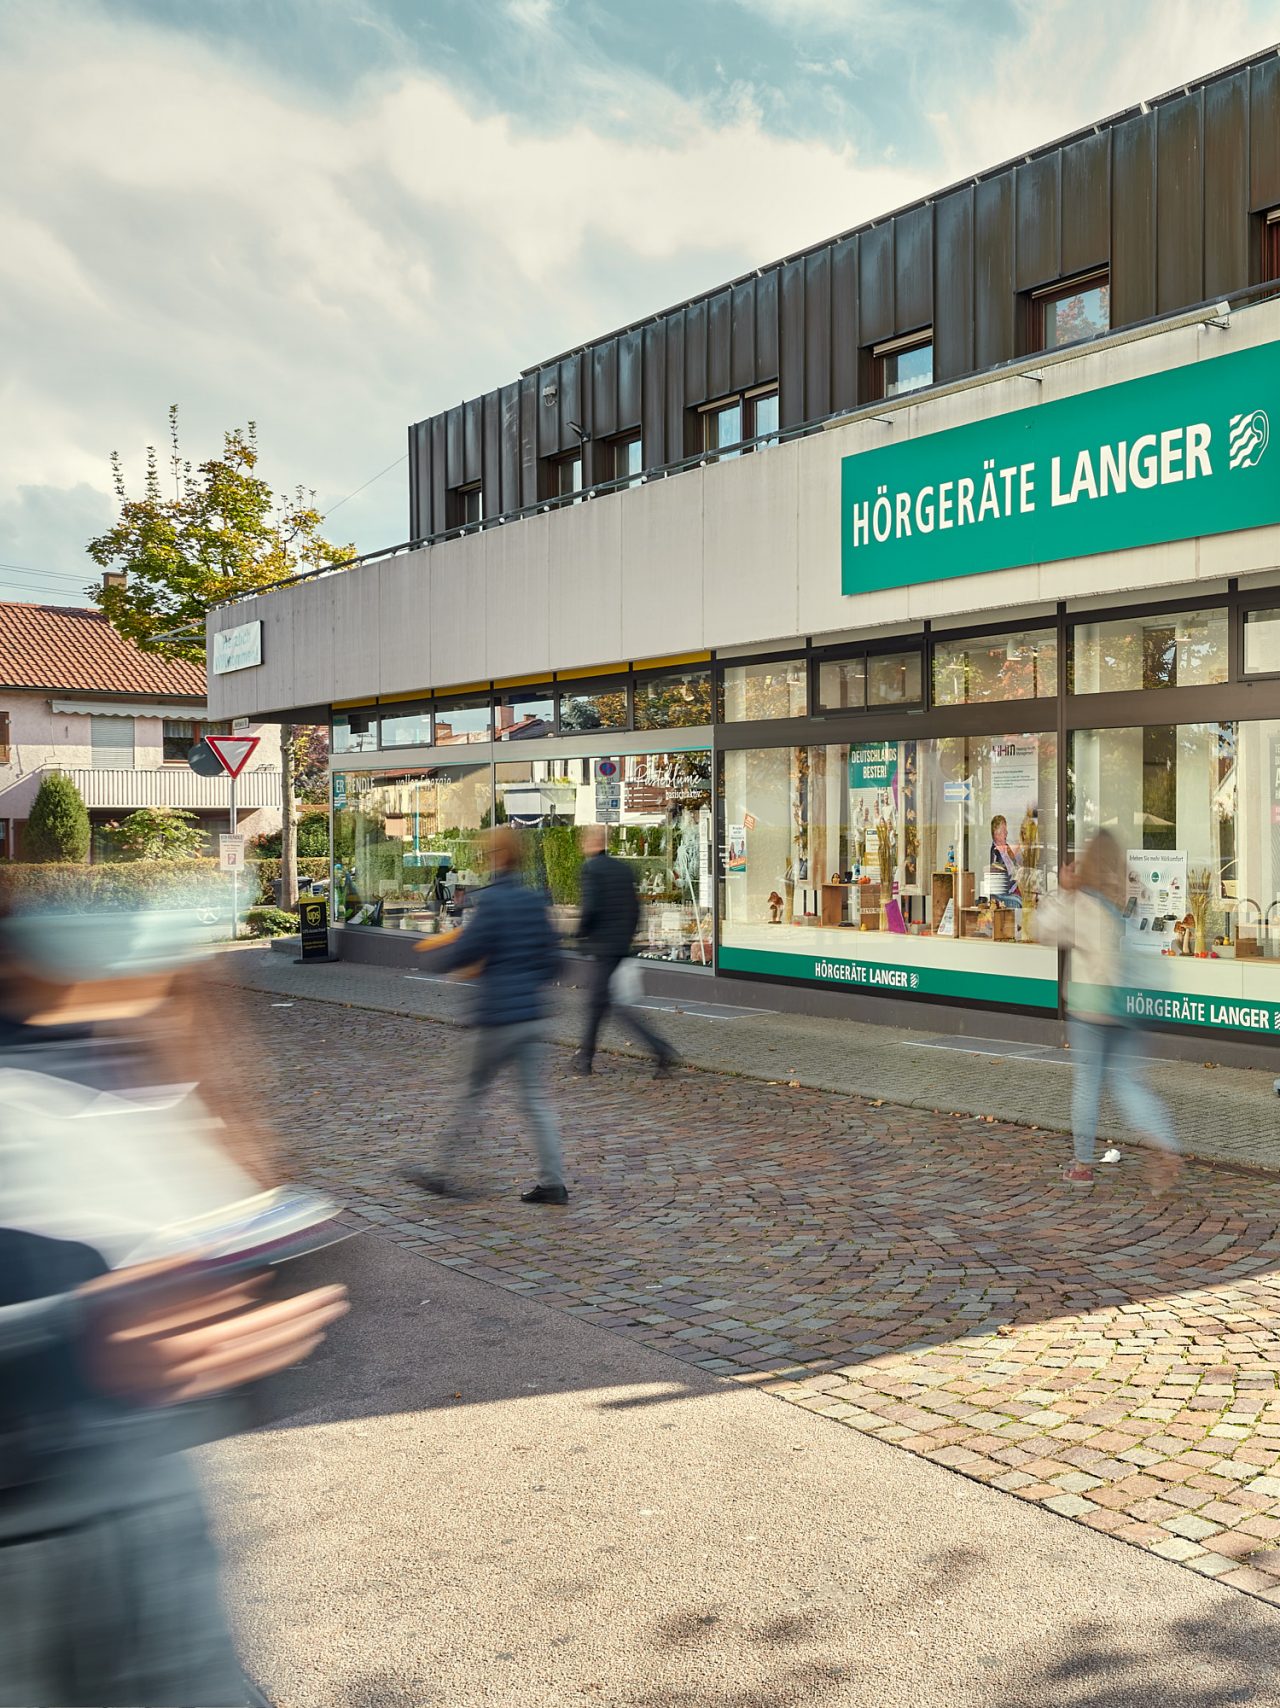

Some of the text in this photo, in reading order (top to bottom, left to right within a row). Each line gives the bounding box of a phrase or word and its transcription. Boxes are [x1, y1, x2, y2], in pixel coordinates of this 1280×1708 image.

[853, 422, 1213, 547] HÖRGERÄTE LANGER
[851, 748, 897, 764] DEUTSCHLANDS
[863, 765, 887, 779] BESTER!
[308, 911, 320, 923] ups
[815, 960, 908, 987] HÖRGERÄTE LANGER
[1126, 993, 1270, 1029] HÖRGERÄTE LANGER
